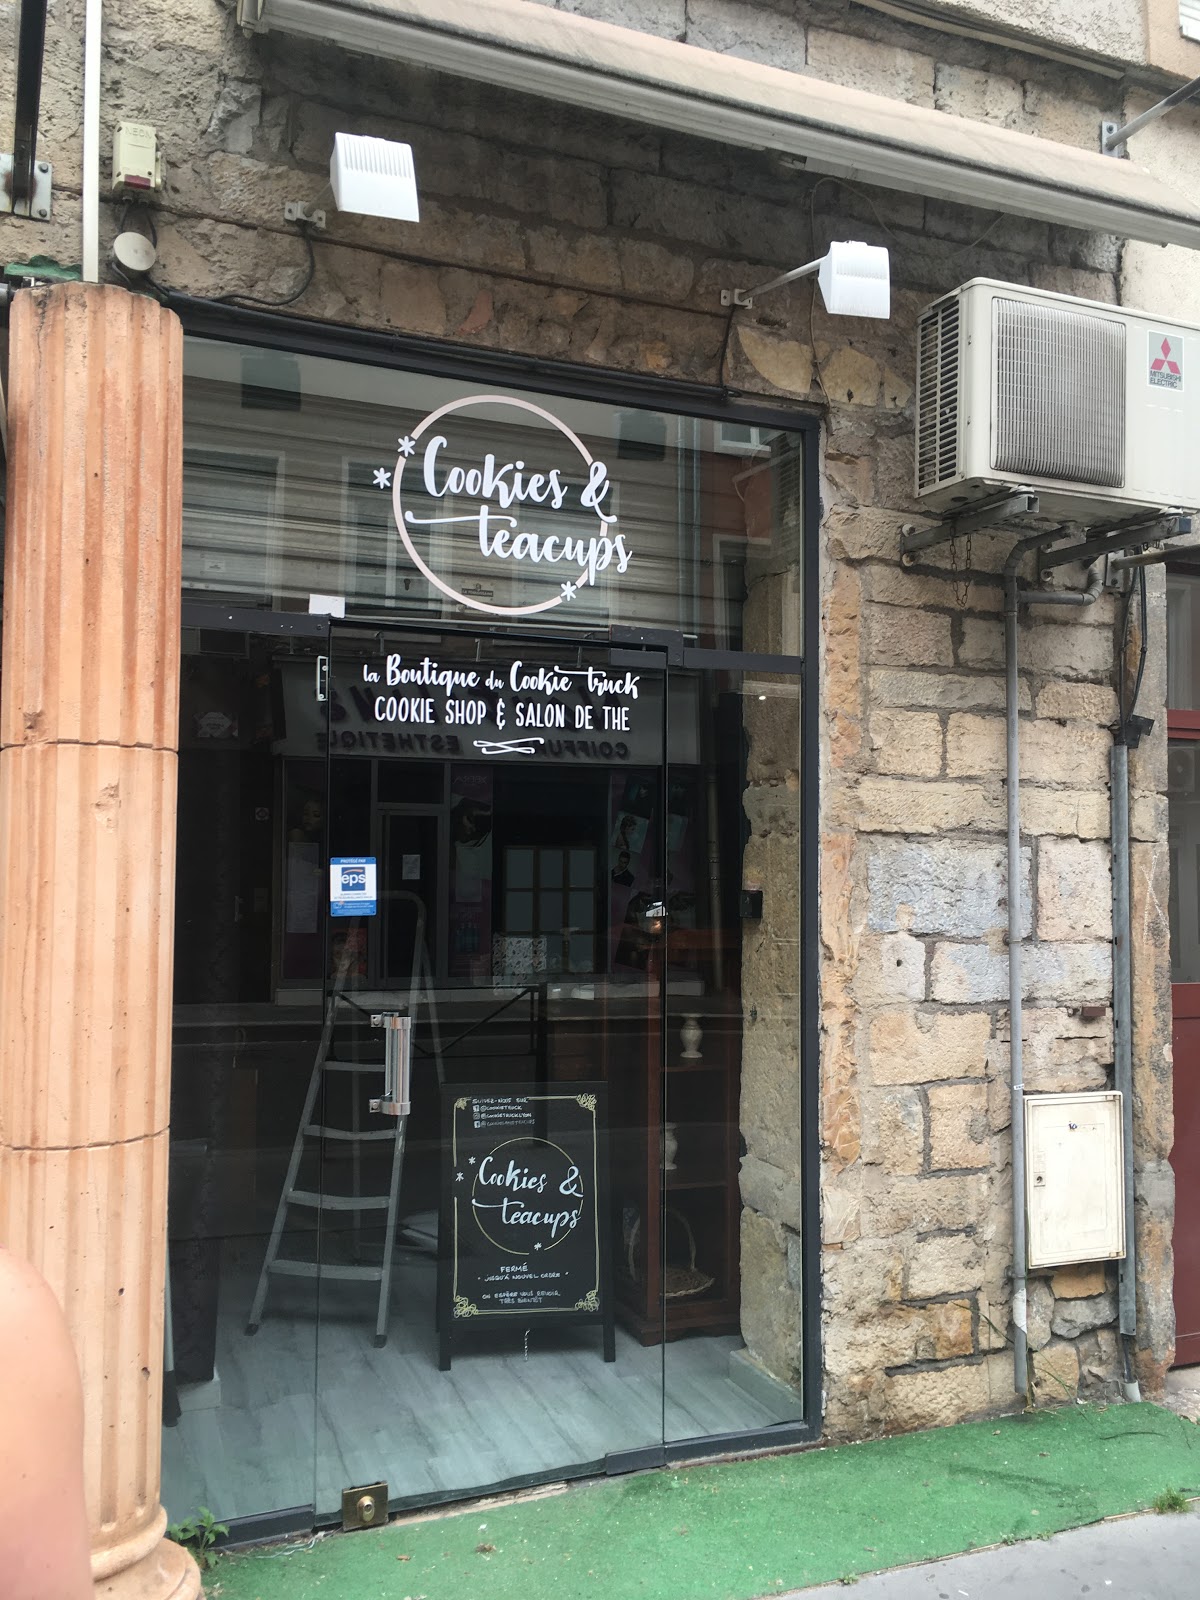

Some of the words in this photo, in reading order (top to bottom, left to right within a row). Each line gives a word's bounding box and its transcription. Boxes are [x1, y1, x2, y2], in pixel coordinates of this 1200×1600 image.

[1150, 370, 1181, 382] MITSUBISHI
[1150, 376, 1177, 388] ELECTRIC
[423, 435, 568, 509] Cookies
[580, 461, 618, 523] &
[404, 505, 632, 586] teacups
[363, 664, 380, 683] la
[386, 653, 480, 696] Boutique
[485, 670, 504, 691] du
[509, 660, 572, 696] Cookie
[554, 665, 641, 699] truck
[374, 696, 435, 724] COOKIE
[445, 699, 487, 726] SHOP
[496, 698, 506, 730] &
[515, 702, 566, 728] SALON
[574, 705, 594, 730] DE
[602, 706, 630, 731] THE
[341, 873, 366, 887] eps
[478, 1156, 548, 1193] Cookies
[559, 1165, 583, 1198] &
[472, 1197, 581, 1238] teacups
[500, 1262, 528, 1273] FERMÉ
